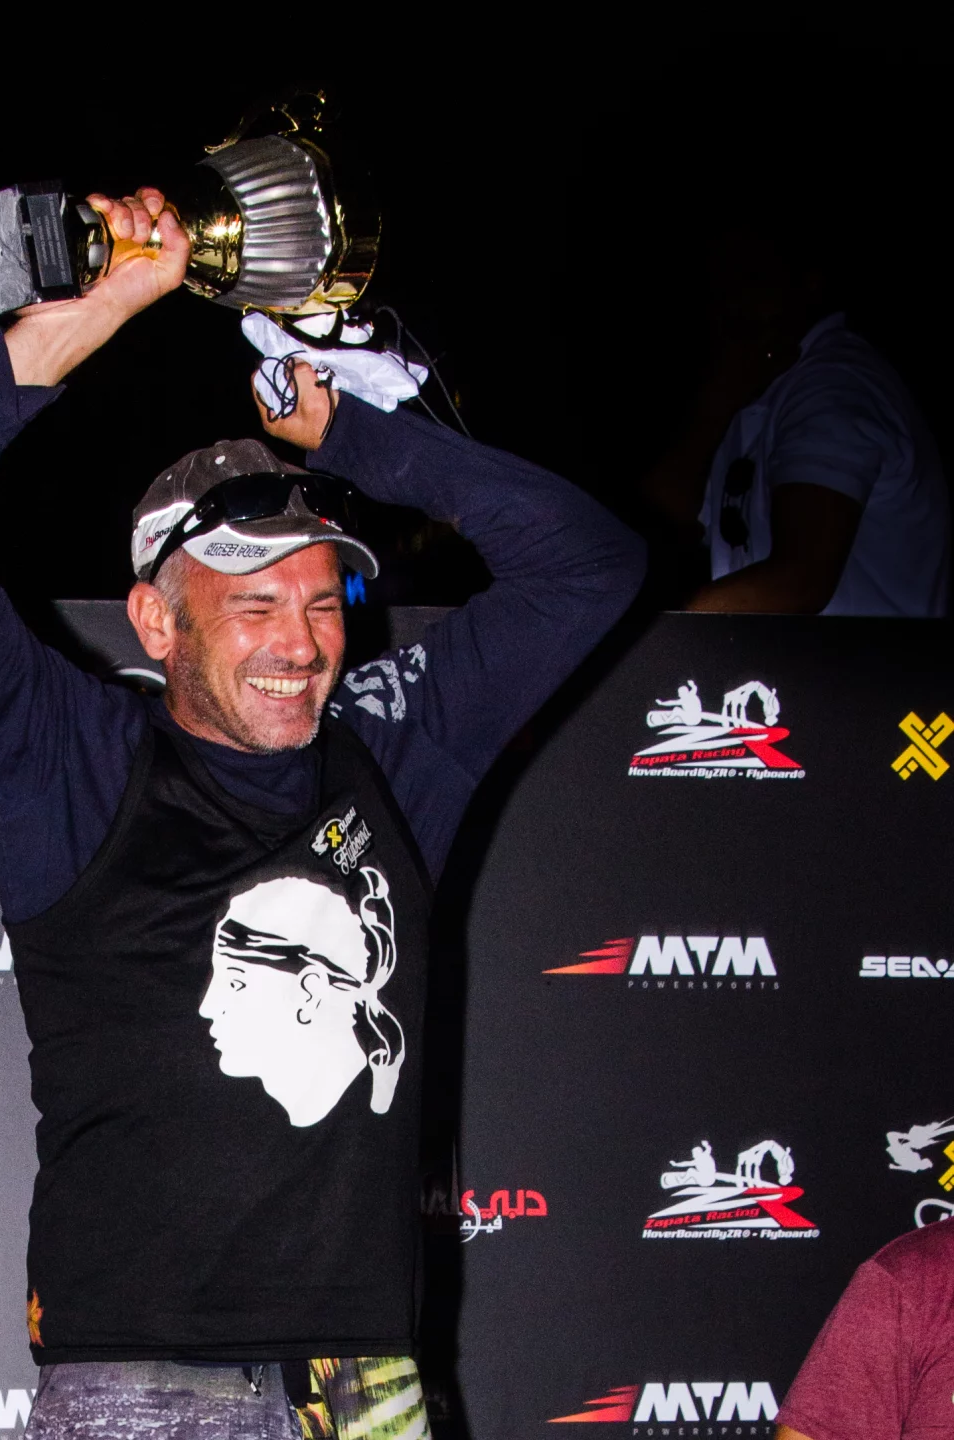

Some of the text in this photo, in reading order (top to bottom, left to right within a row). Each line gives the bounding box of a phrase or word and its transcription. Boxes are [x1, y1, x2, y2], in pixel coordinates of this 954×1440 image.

[628, 935, 777, 976] MTM
[628, 980, 780, 990] POWERSPORTS
[633, 1382, 780, 1422] MTM
[632, 1427, 771, 1436] POWERSPORT
